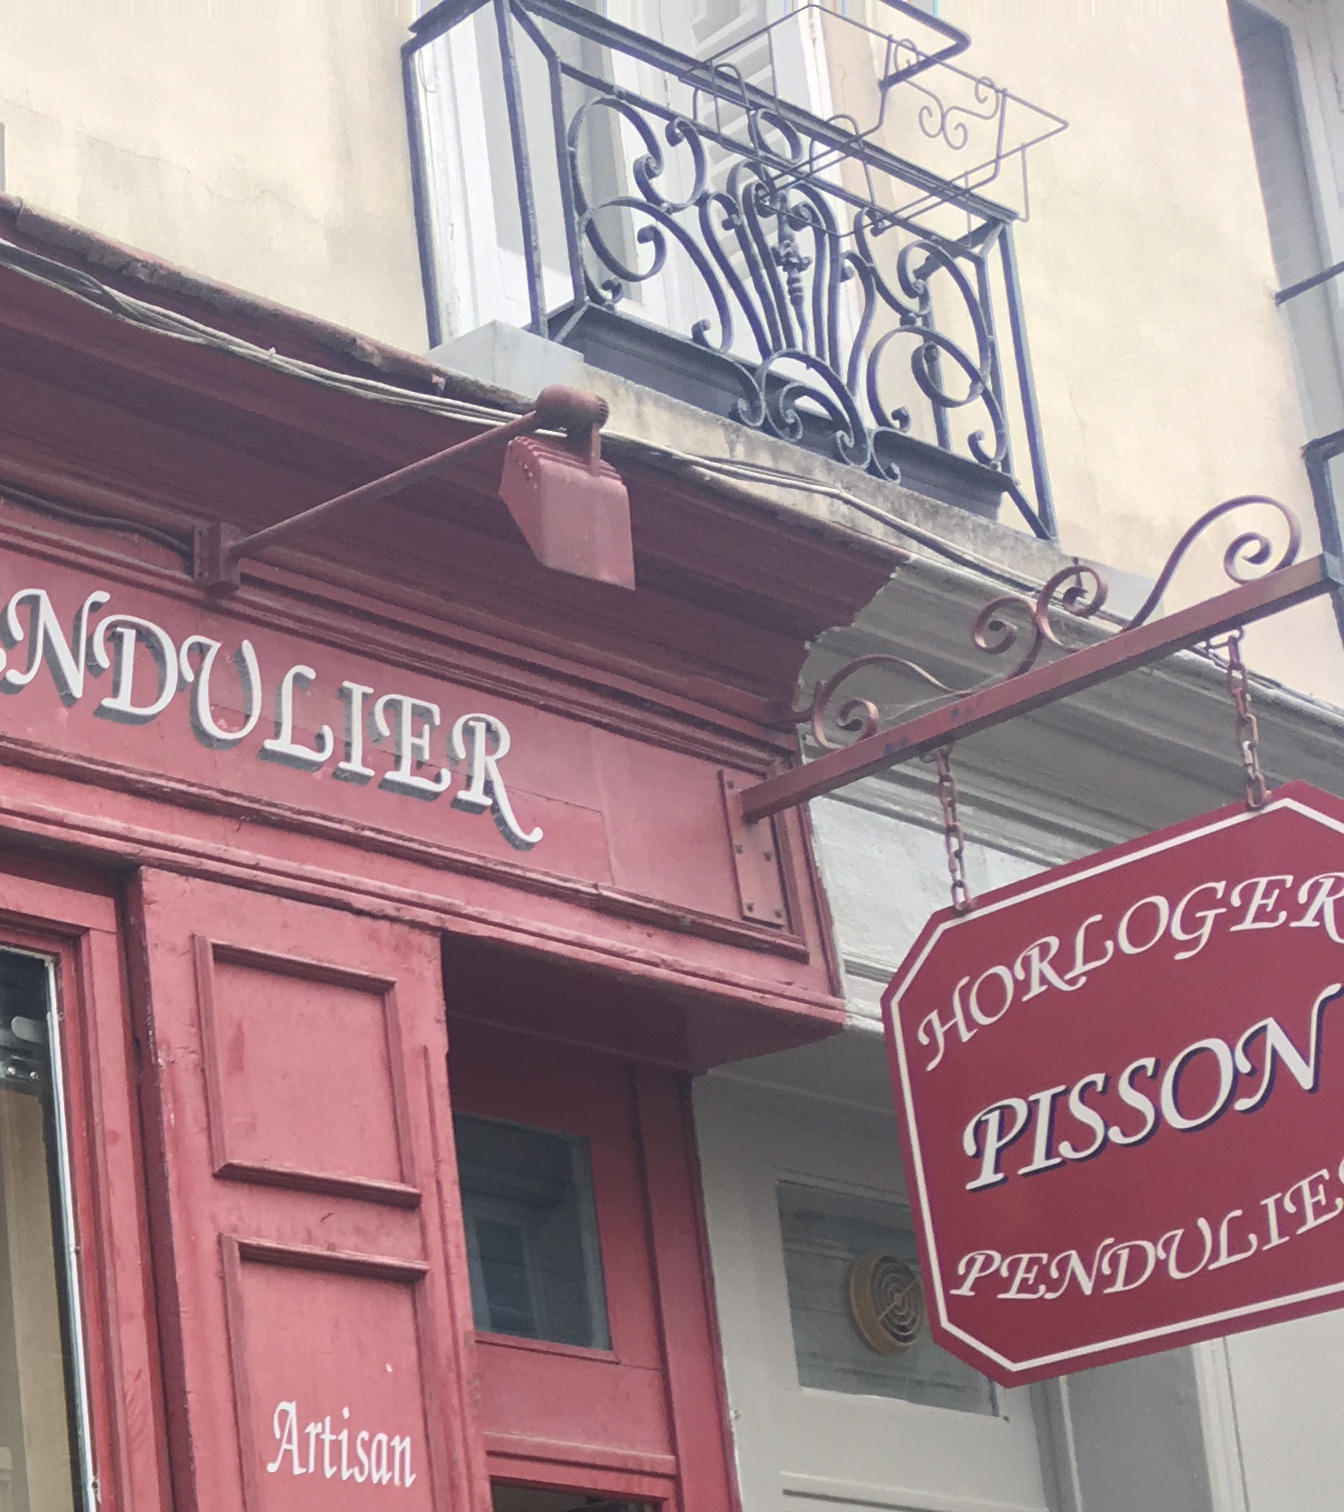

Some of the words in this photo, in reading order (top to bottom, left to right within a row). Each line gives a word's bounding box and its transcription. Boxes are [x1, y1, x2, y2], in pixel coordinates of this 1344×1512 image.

[918, 871, 1344, 1071] HORLOGER
[963, 984, 1343, 1191] PISSON
[950, 1157, 1344, 1300] PENDULIE
[267, 1401, 417, 1488] Artisan
